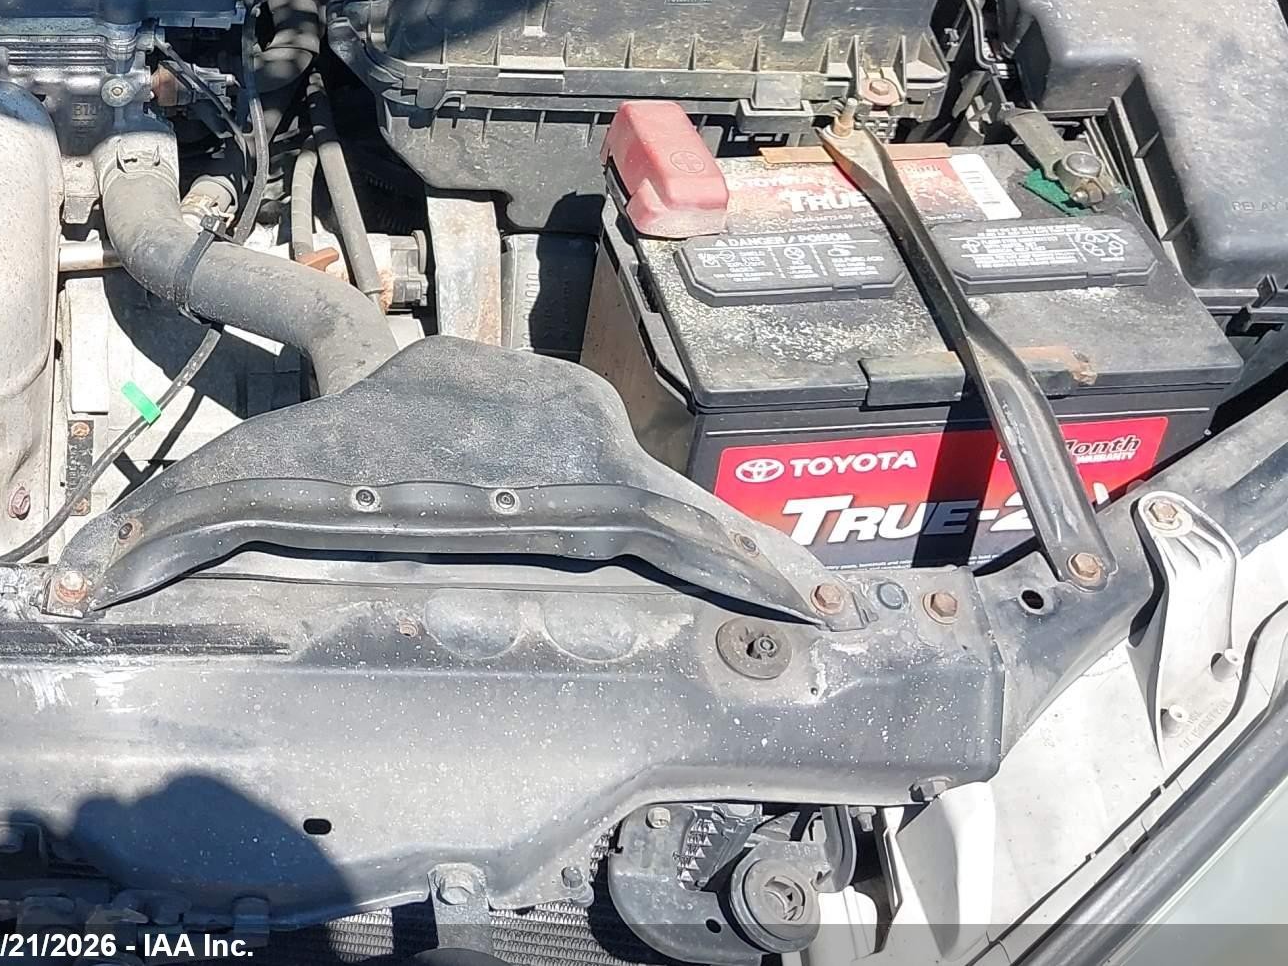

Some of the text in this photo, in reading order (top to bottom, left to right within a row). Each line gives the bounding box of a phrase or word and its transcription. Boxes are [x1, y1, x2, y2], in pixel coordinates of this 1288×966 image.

[728, 235, 785, 246] DANGER
[797, 232, 852, 243] POISON
[790, 450, 918, 478] TOYOTA
